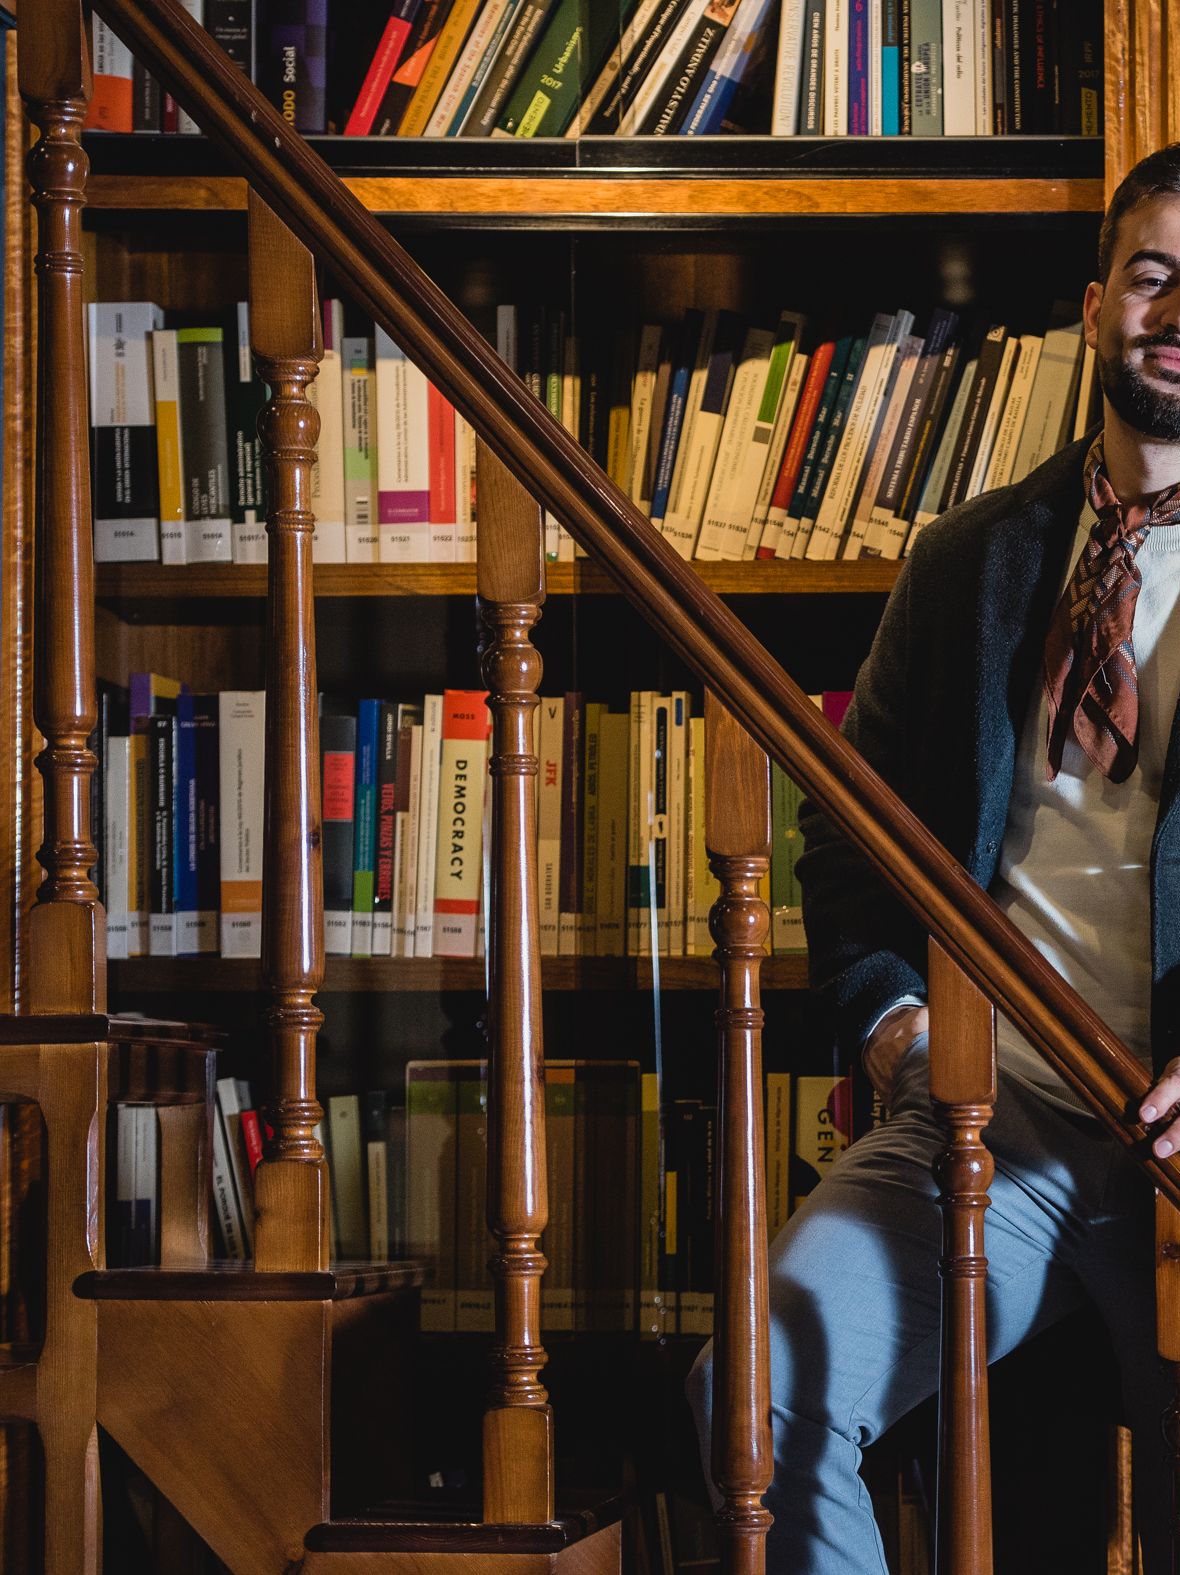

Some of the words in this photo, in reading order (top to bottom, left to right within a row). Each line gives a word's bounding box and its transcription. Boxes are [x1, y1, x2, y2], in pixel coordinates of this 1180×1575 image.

[811, 29, 819, 46] AÑOS
[812, 12, 820, 27] CIEN
[283, 46, 294, 82] Social
[683, 26, 715, 77] ANDALUZ
[810, 48, 818, 57] DE
[540, 73, 563, 90] 2017
[808, 59, 817, 91] GRANDES
[806, 92, 816, 128] DISCURSOS
[798, 465, 811, 493] Manual
[807, 429, 821, 459] Derecho
[817, 405, 827, 422] Mar
[811, 469, 825, 497] Manual
[821, 433, 835, 464] Derecho
[832, 409, 842, 426] Mar
[885, 469, 900, 498] SISTEMA
[894, 428, 912, 469] TRIBUTARIO
[907, 396, 922, 428] ESPAÑOL
[545, 760, 554, 785] JFK
[380, 783, 392, 813] VETOS,
[379, 815, 392, 847] PINZAS
[450, 759, 466, 880] DEMOCRACY
[378, 857, 391, 899] ERRORES
[817, 1109, 832, 1162] GEN
